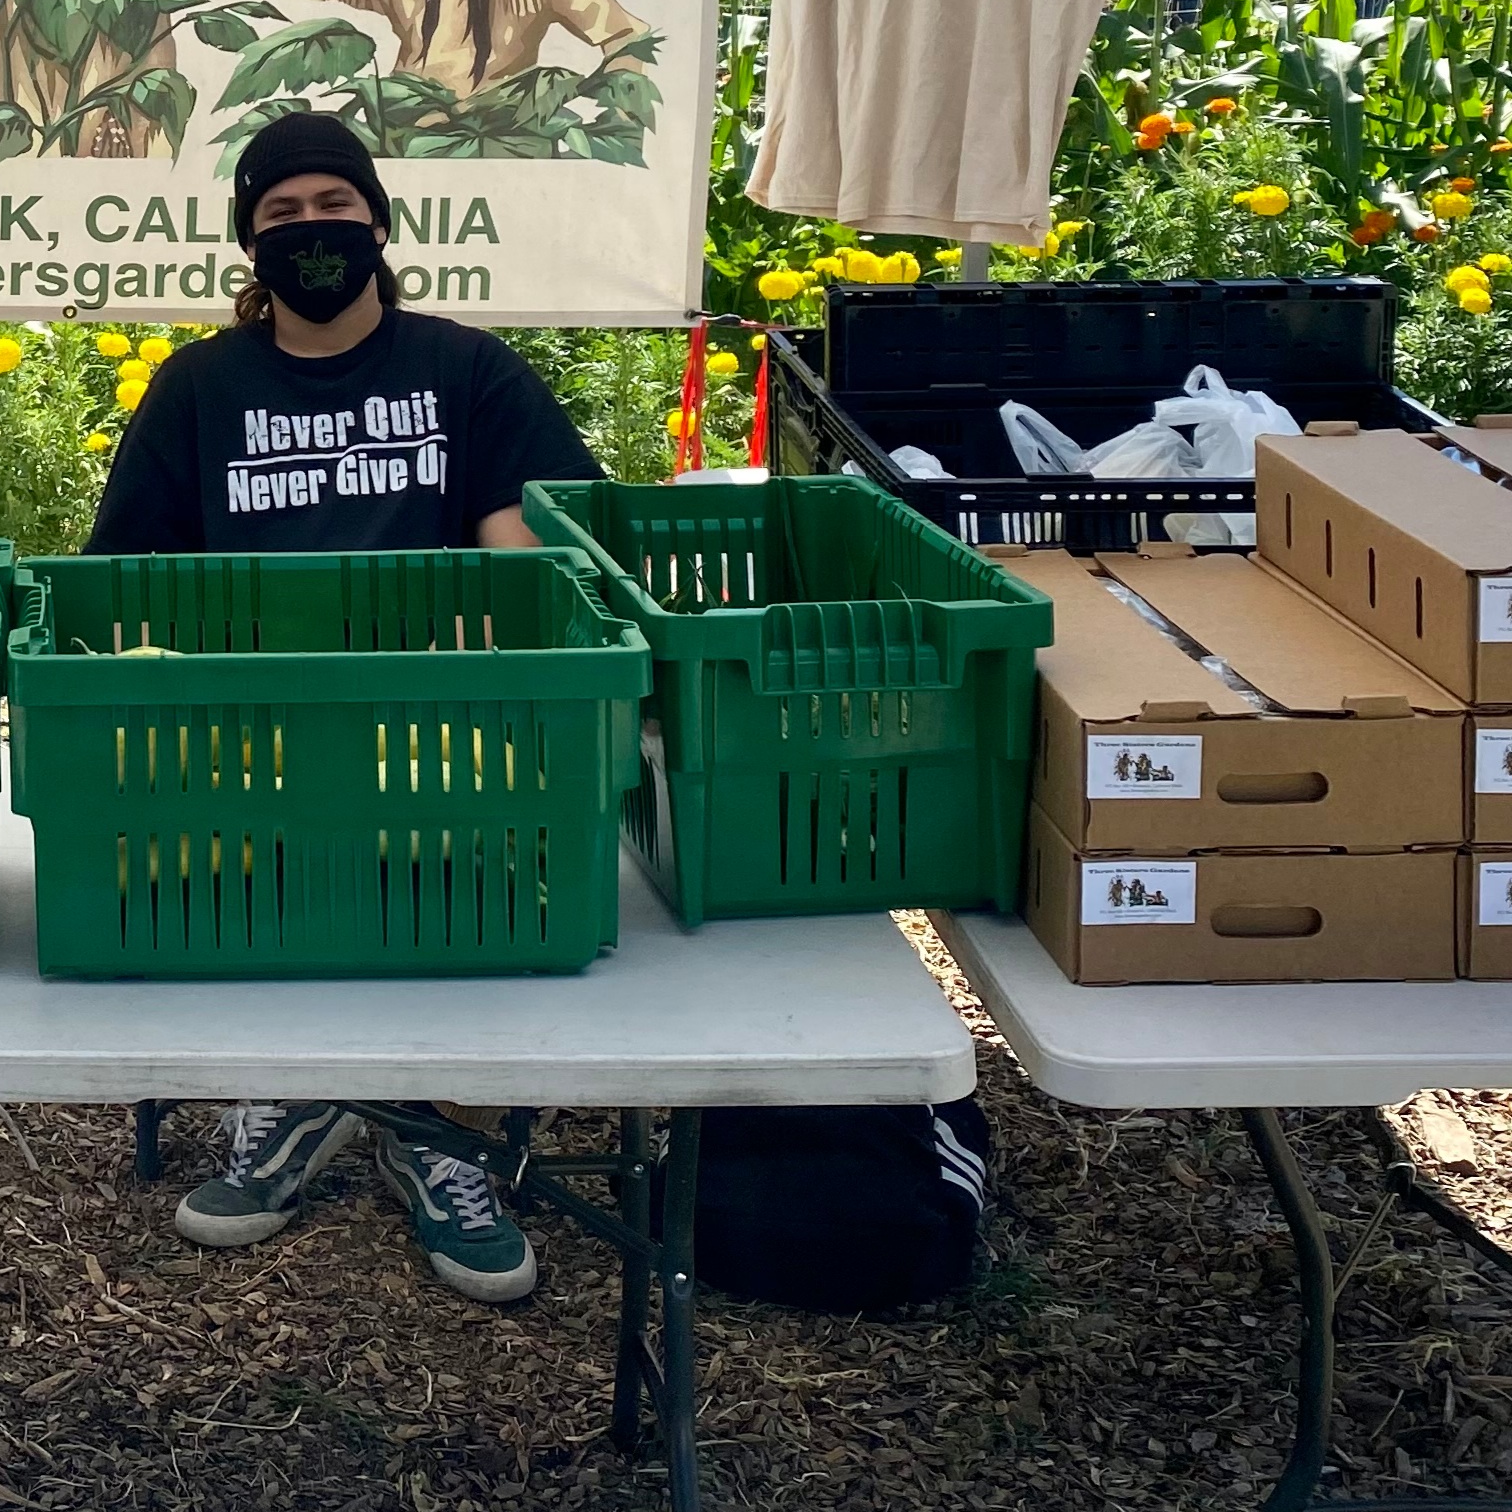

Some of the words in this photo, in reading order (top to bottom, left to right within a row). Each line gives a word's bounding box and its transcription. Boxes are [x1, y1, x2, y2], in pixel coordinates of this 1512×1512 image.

[84, 194, 500, 245] CALINIA
[245, 409, 356, 455] Never
[364, 390, 439, 441] Quit
[227, 469, 327, 513] Never
[336, 453, 408, 496] Give
